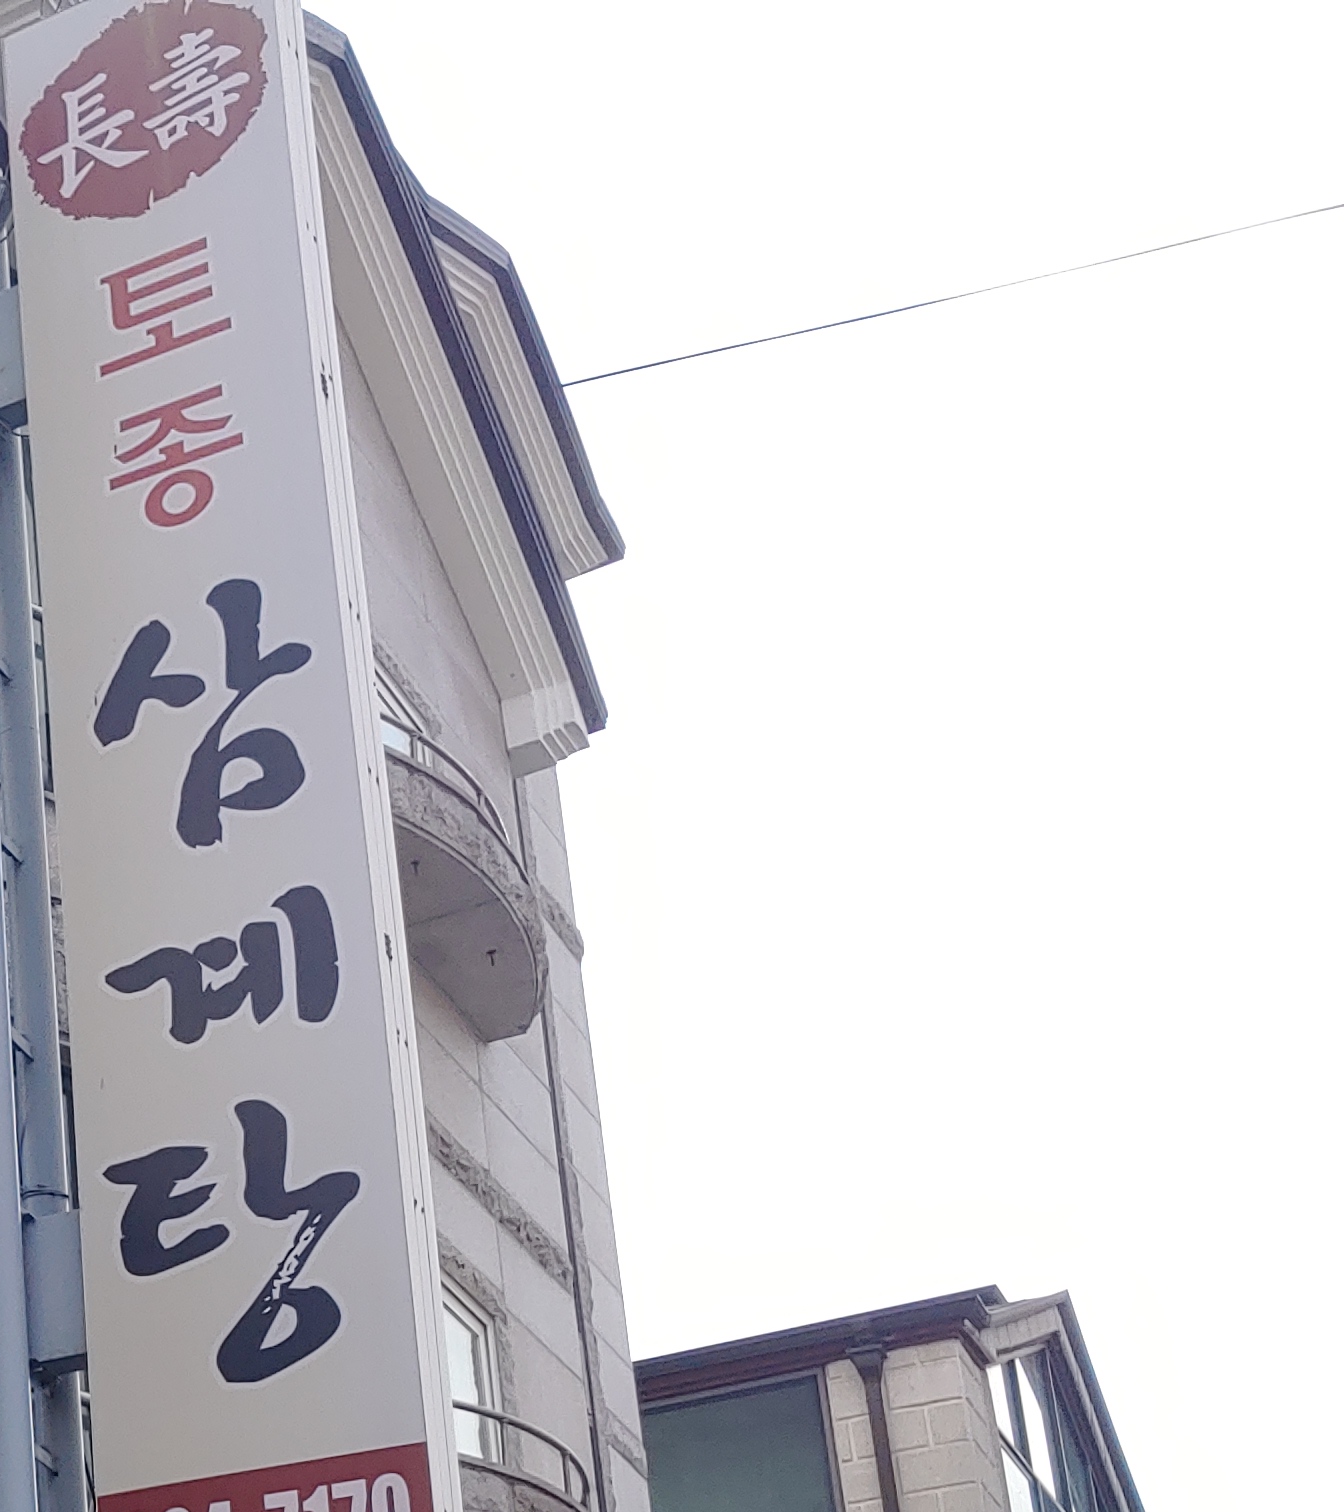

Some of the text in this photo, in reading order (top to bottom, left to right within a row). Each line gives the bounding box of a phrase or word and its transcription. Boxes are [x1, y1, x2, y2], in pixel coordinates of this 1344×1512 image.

[36, 28, 250, 198] 長壽
[98, 237, 244, 528] 토종
[93, 578, 360, 1383] 삼계탕
